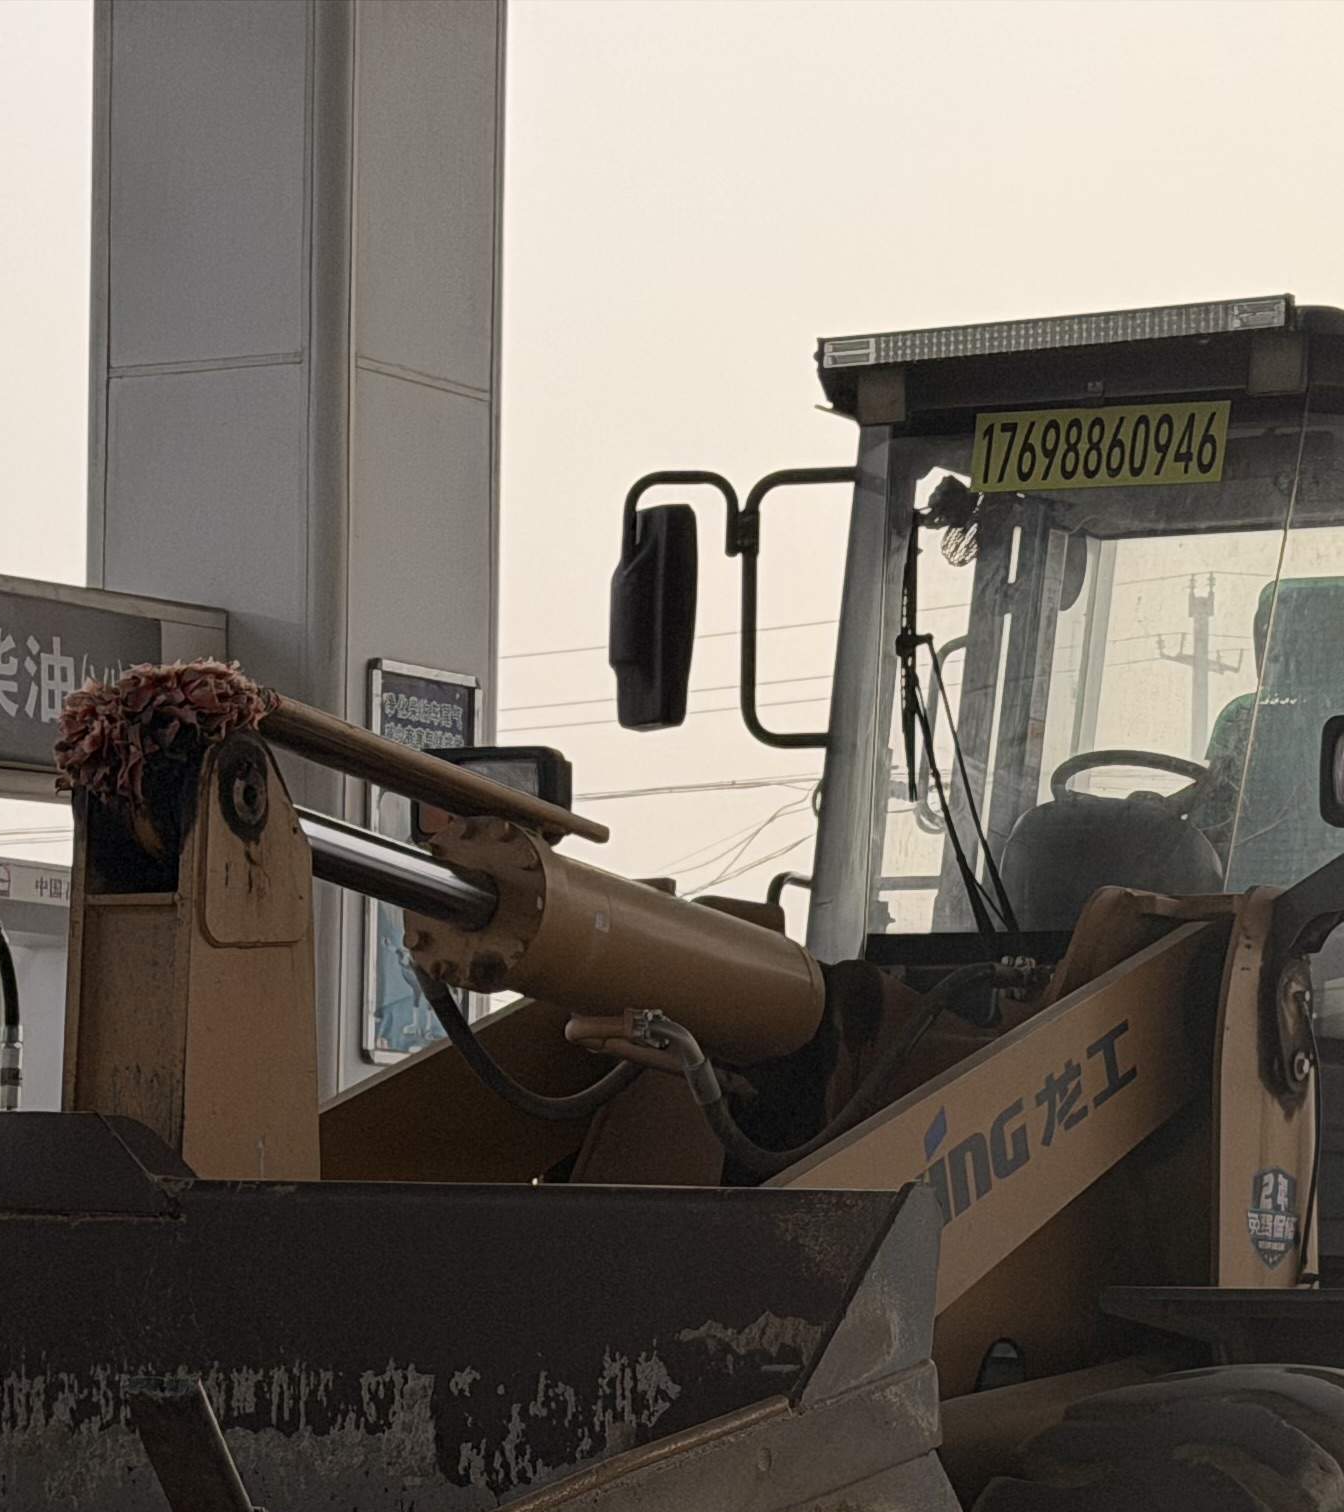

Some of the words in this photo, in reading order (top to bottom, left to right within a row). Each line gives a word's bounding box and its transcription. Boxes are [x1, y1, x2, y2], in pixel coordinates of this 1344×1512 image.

[982, 411, 1217, 484] 17698860946
[35, 876, 70, 899] 中国
[1035, 1018, 1137, 1147] 龙工
